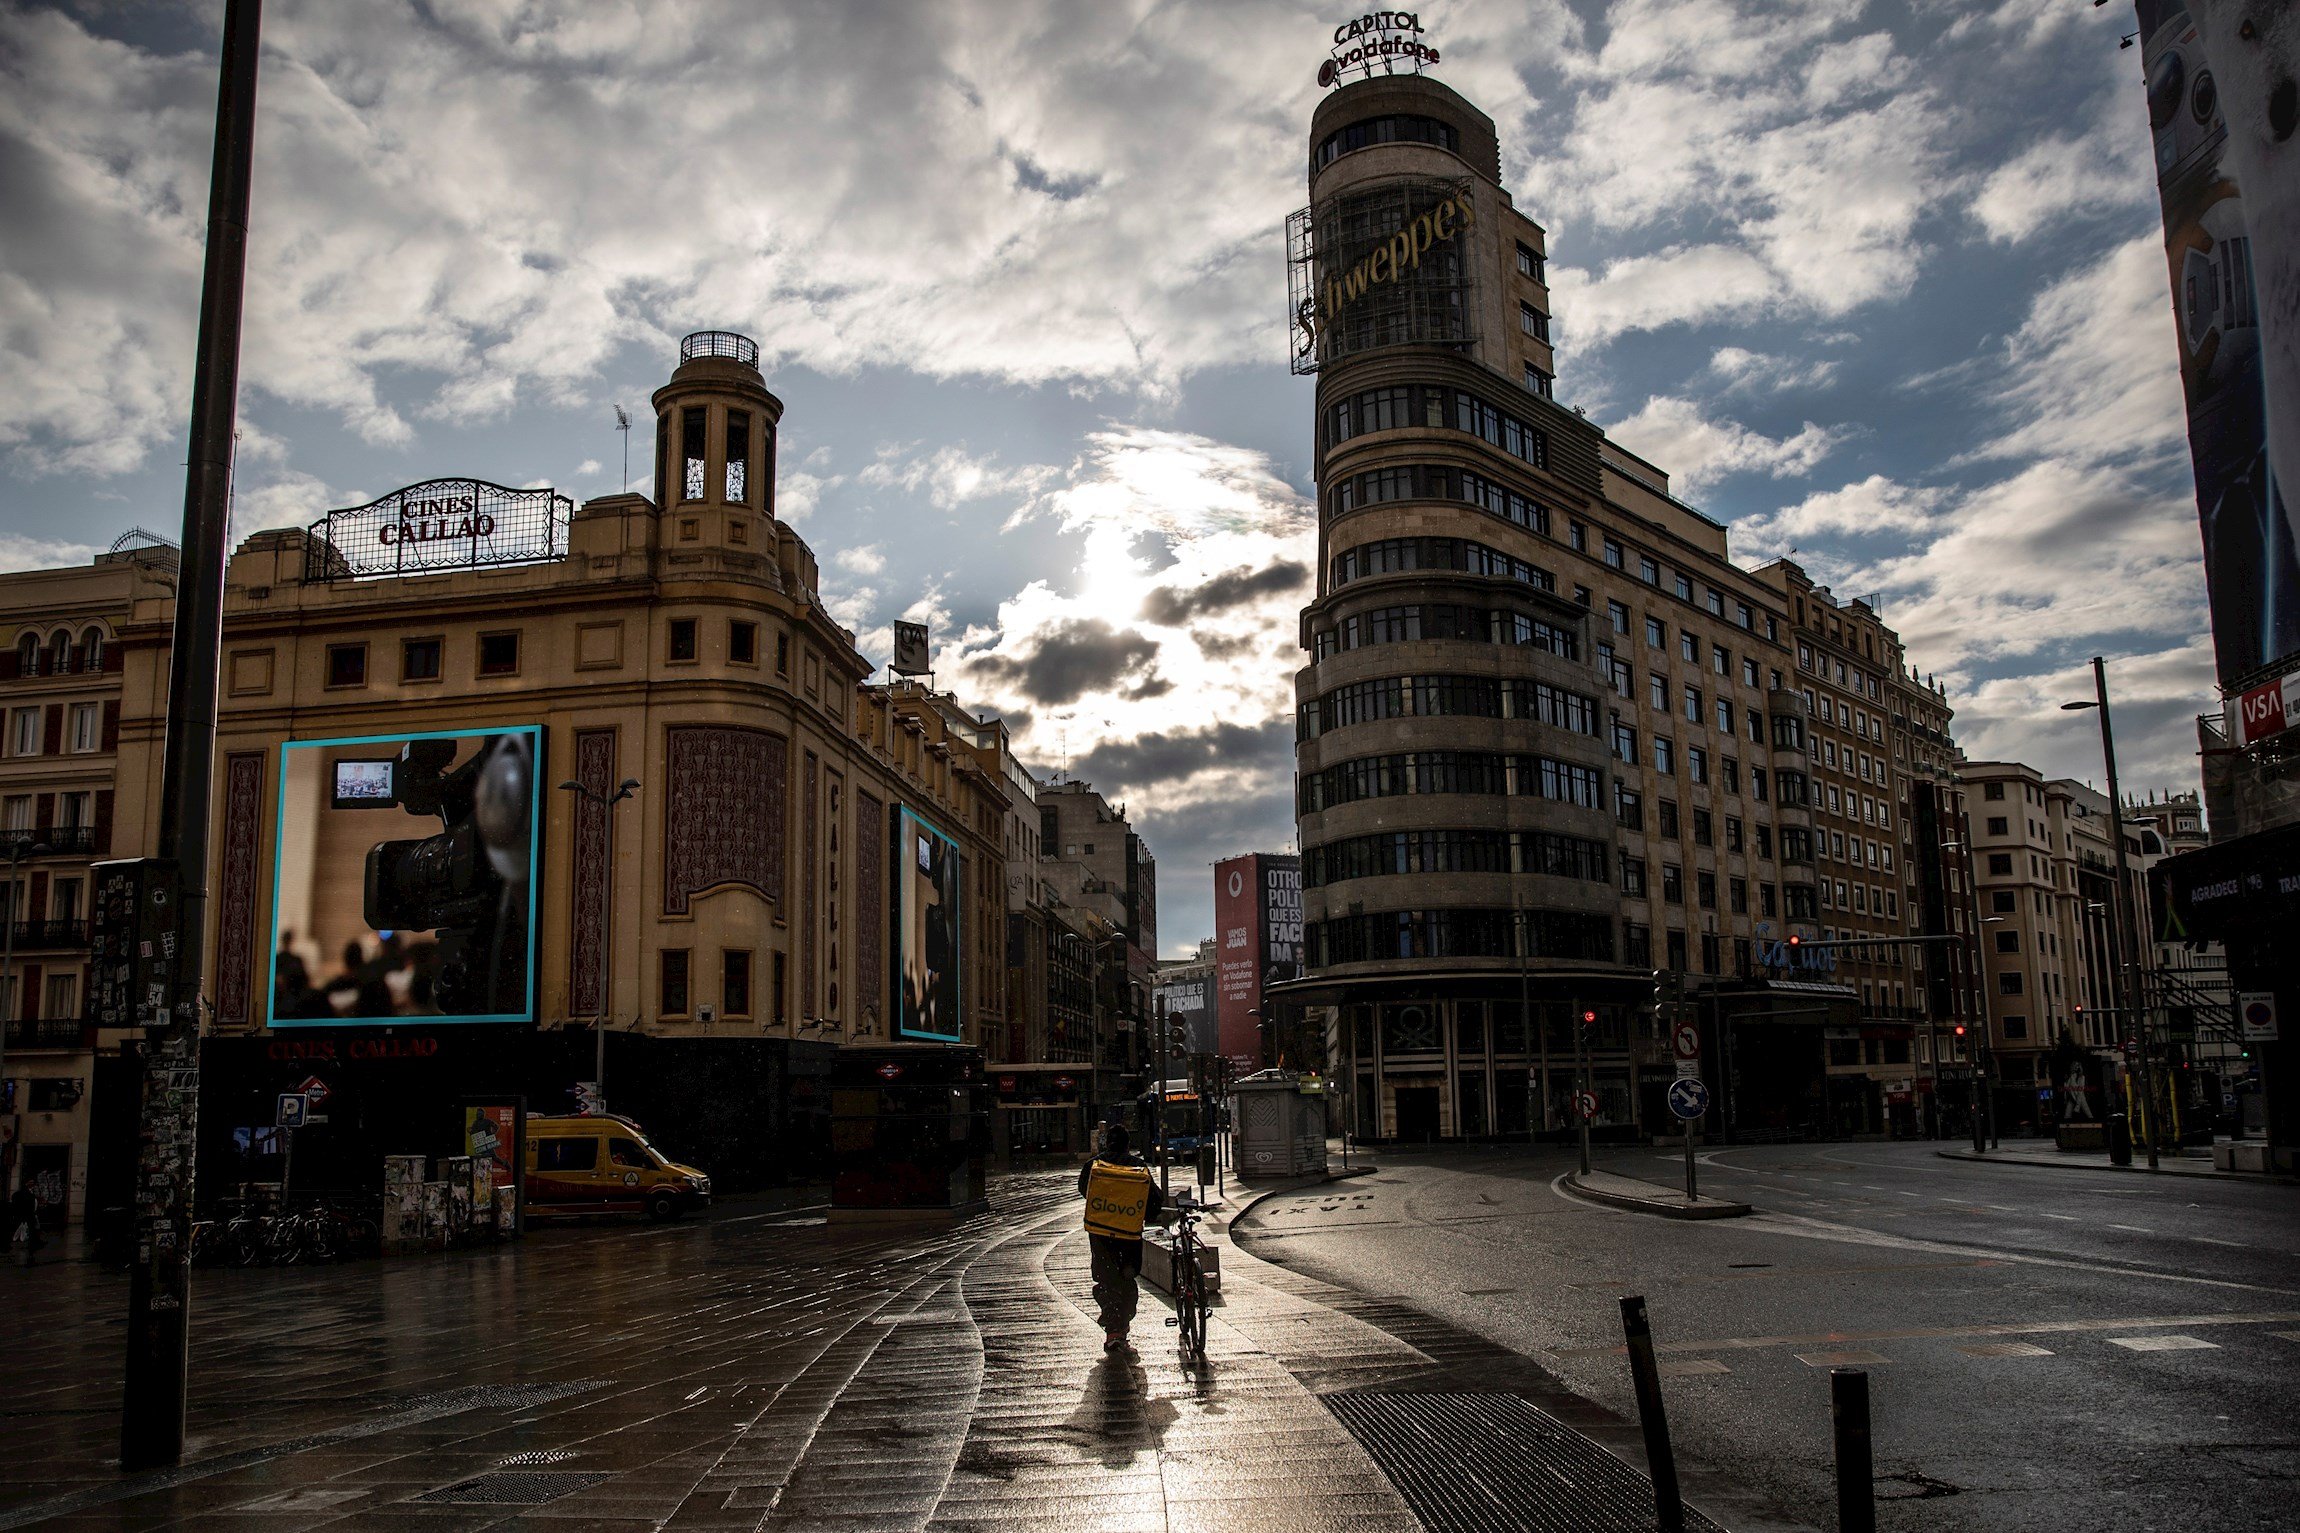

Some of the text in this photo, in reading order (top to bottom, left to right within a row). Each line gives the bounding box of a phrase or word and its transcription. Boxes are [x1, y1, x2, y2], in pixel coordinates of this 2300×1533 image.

[1334, 11, 1425, 45] CAPITOL
[1337, 35, 1441, 69] vodafone
[1298, 184, 1477, 358] Schweppes
[402, 495, 473, 518] CINES
[379, 514, 495, 546] CALLAO
[2244, 690, 2281, 724] VSA
[829, 784, 839, 1012] CALLAO
[1268, 889, 1303, 909] POLÍ
[2191, 880, 2239, 902] AGRADECE
[1269, 908, 1302, 923] QUE ES
[1226, 936, 1247, 949] JUAN
[1227, 926, 1247, 940] VAMOS
[1270, 942, 1293, 962] DA
[1222, 959, 1253, 971] Puedes verlo
[1230, 970, 1253, 979] Vodafone
[1186, 983, 1197, 996] QUE
[1197, 982, 1204, 994] ES
[1223, 981, 1253, 991] sin sobornar
[1233, 991, 1247, 999] nadie
[1172, 994, 1205, 1012] FACHADA
[265, 1038, 336, 1063] CINES
[347, 1036, 438, 1061] CALLAO
[282, 1097, 300, 1123] P
[1091, 1197, 1136, 1217] Glovo
[1268, 1204, 1371, 1216] TAXI
